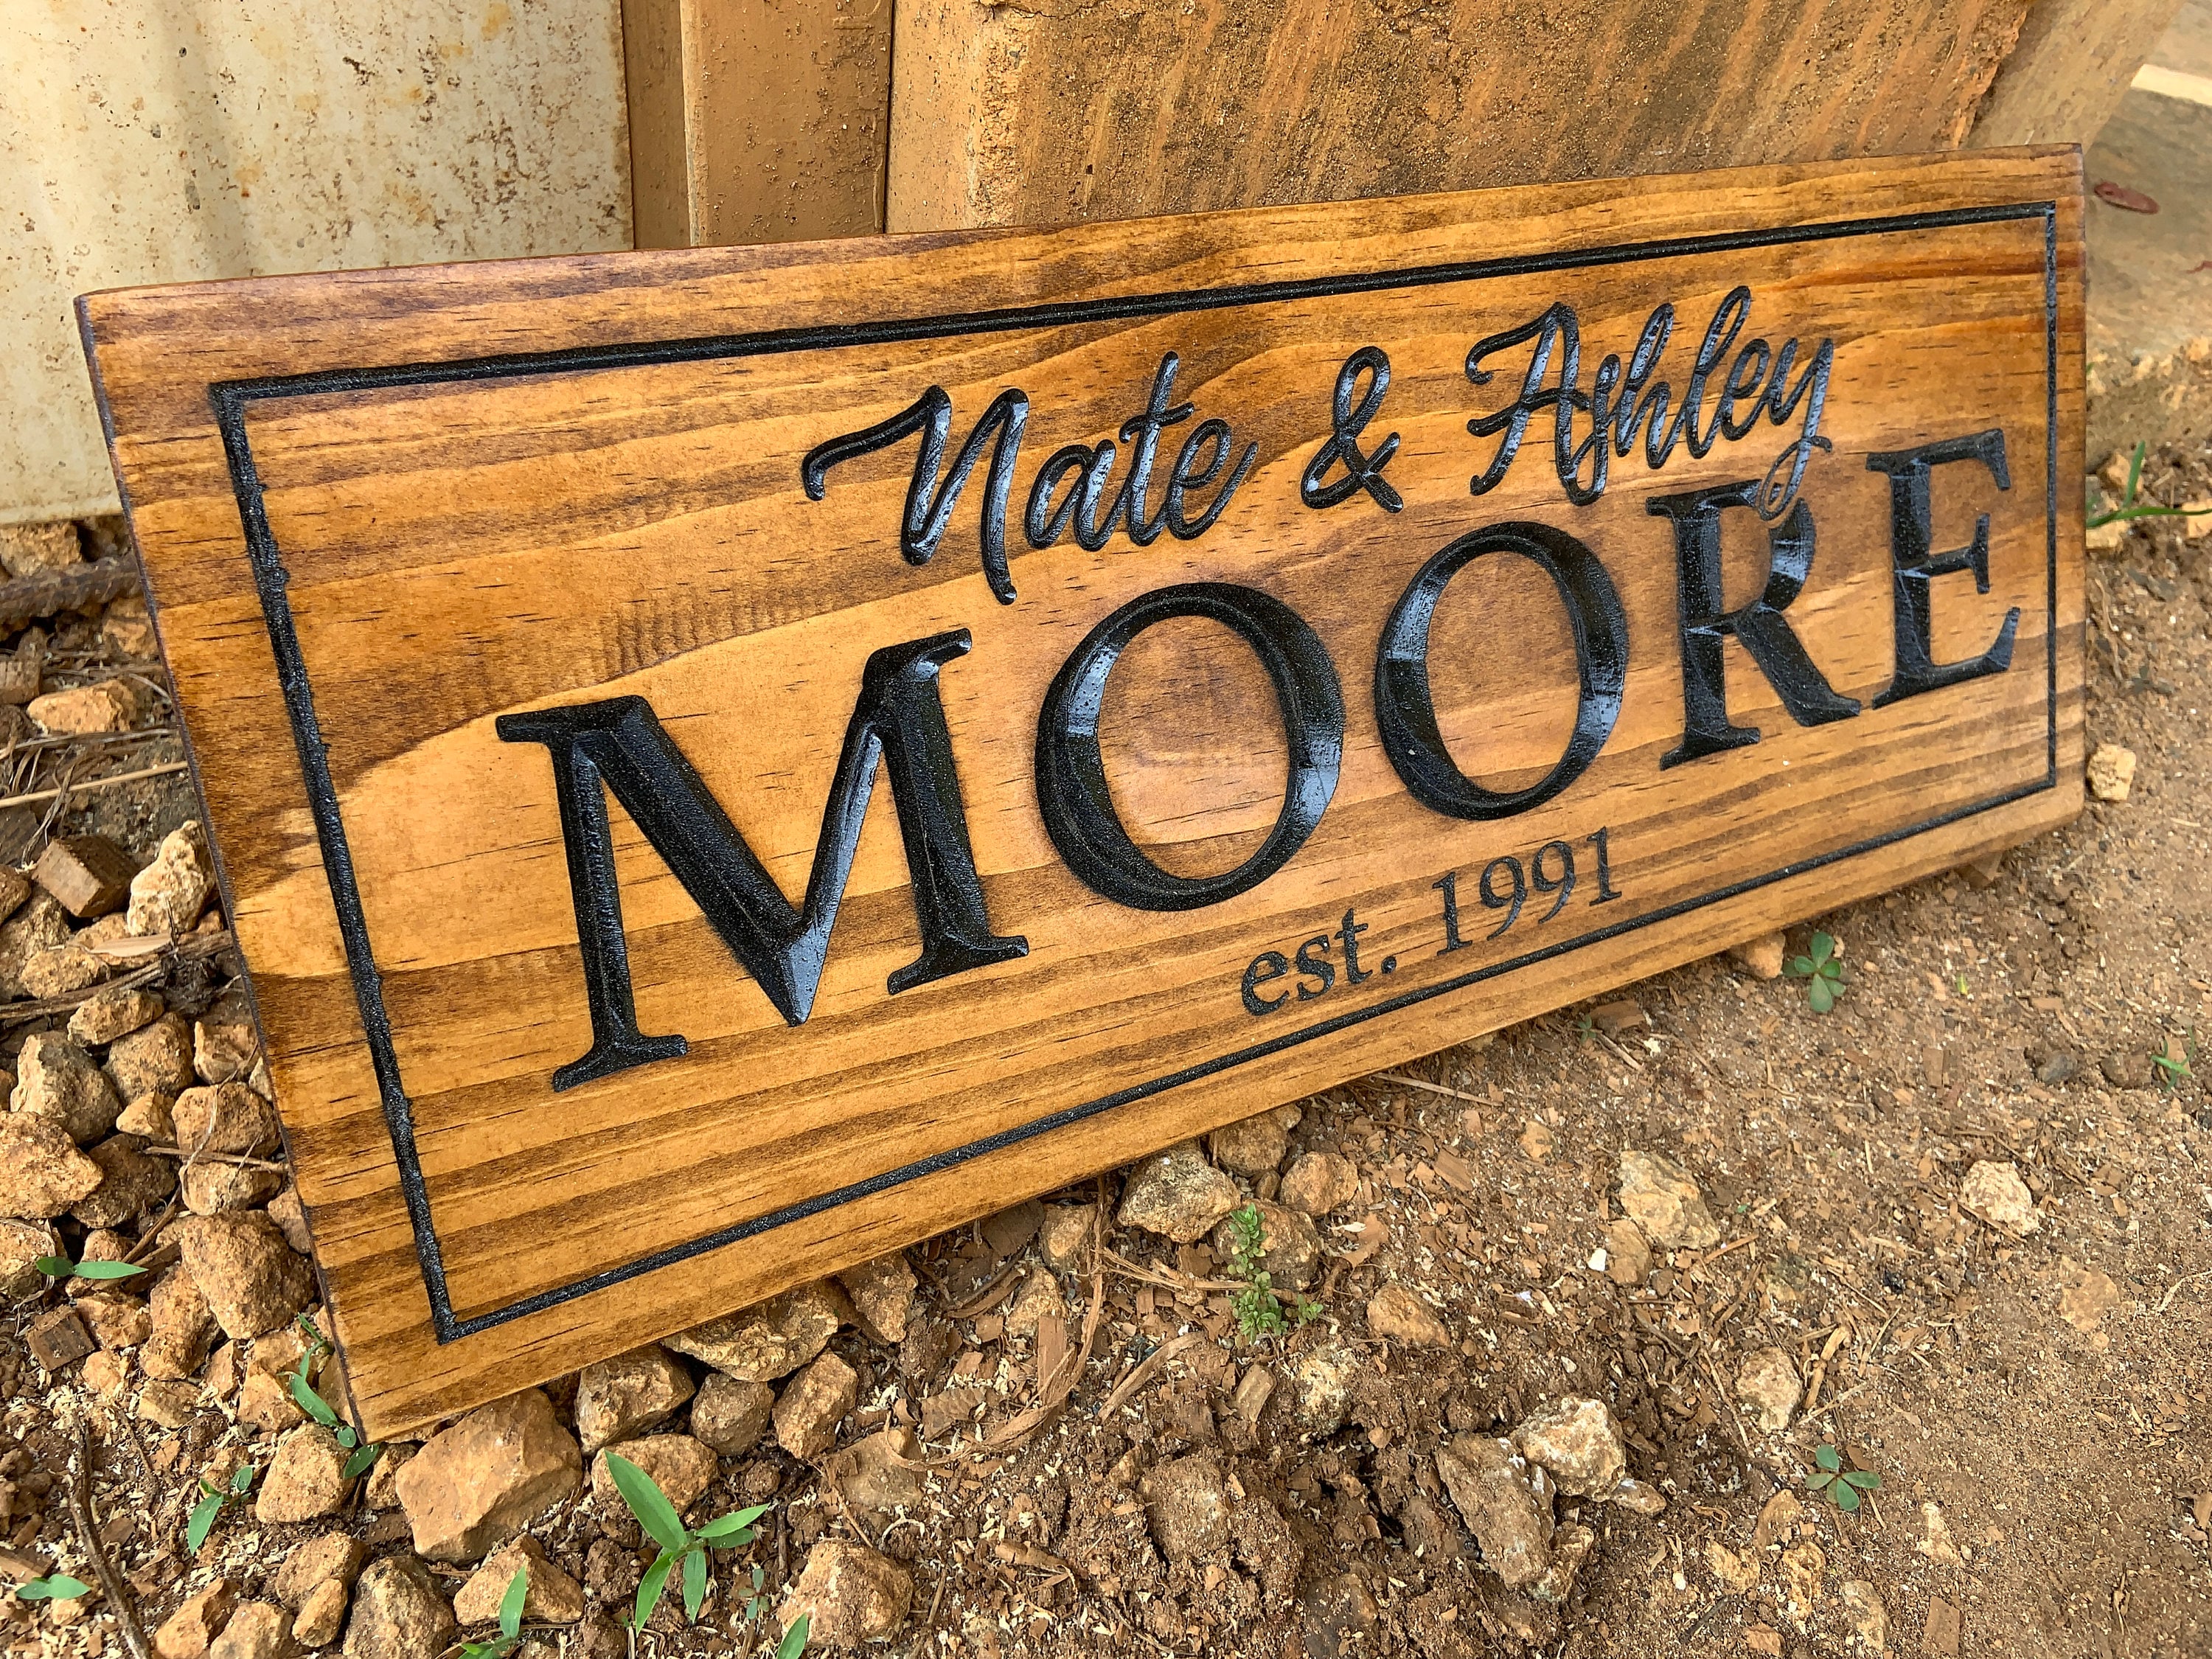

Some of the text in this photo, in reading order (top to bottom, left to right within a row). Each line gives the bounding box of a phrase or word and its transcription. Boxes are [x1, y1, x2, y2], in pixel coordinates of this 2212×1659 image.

[802, 285, 1835, 605] Nate & Ashley
[495, 430, 2020, 1092] MOORE
[1241, 825, 1624, 1017] est. 1991
